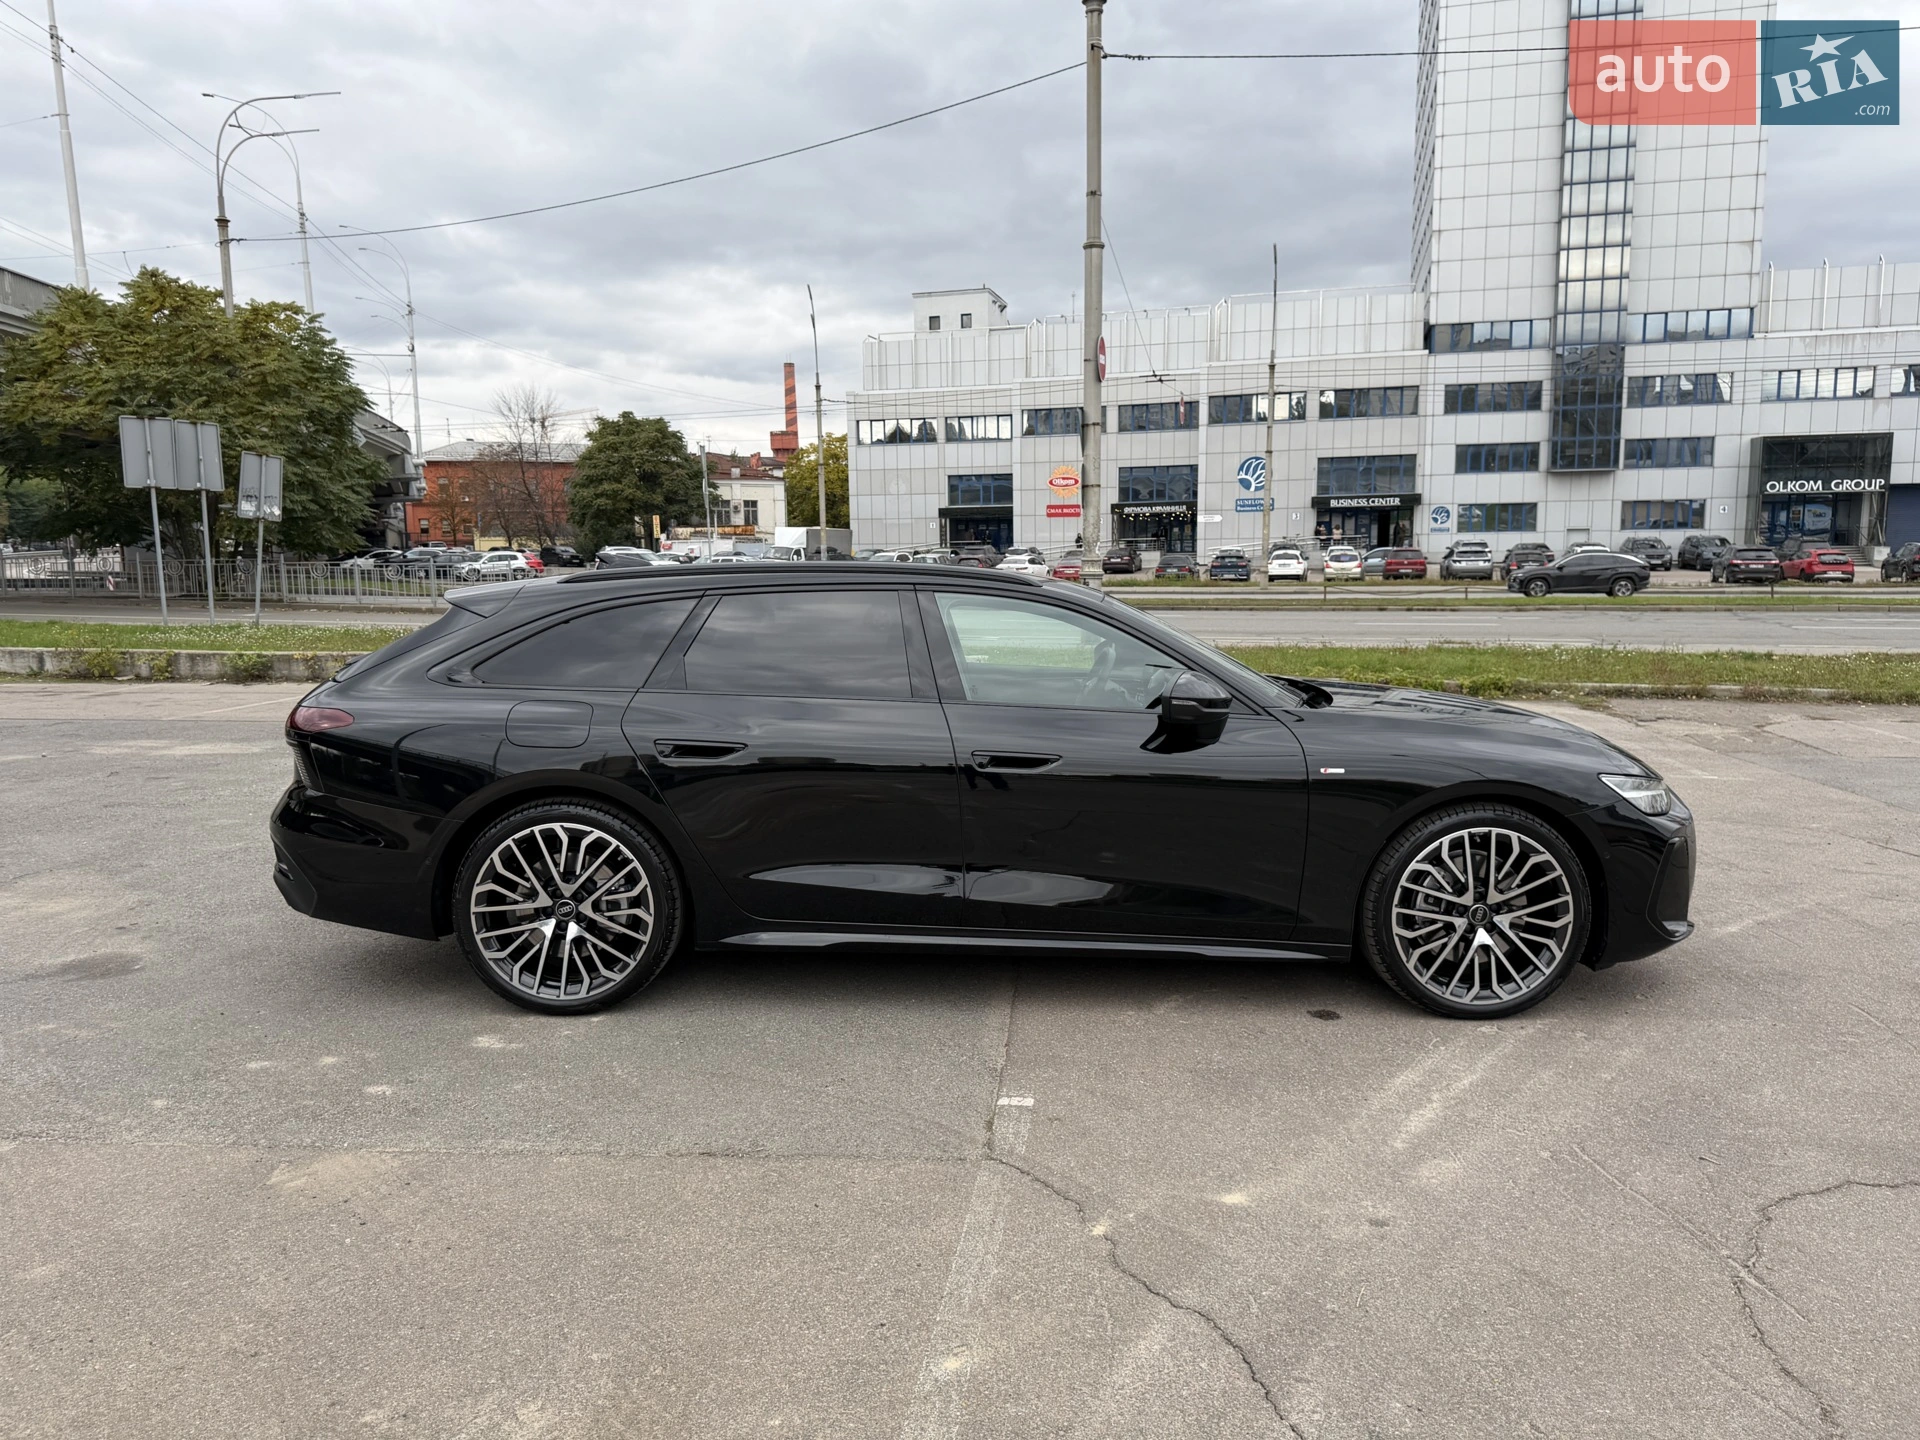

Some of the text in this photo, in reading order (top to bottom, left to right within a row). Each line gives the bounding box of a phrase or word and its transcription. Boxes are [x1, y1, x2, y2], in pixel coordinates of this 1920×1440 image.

[1766, 479, 1885, 492] OLKOM GROUP
[1330, 497, 1401, 507] BUSINESS CENTER
